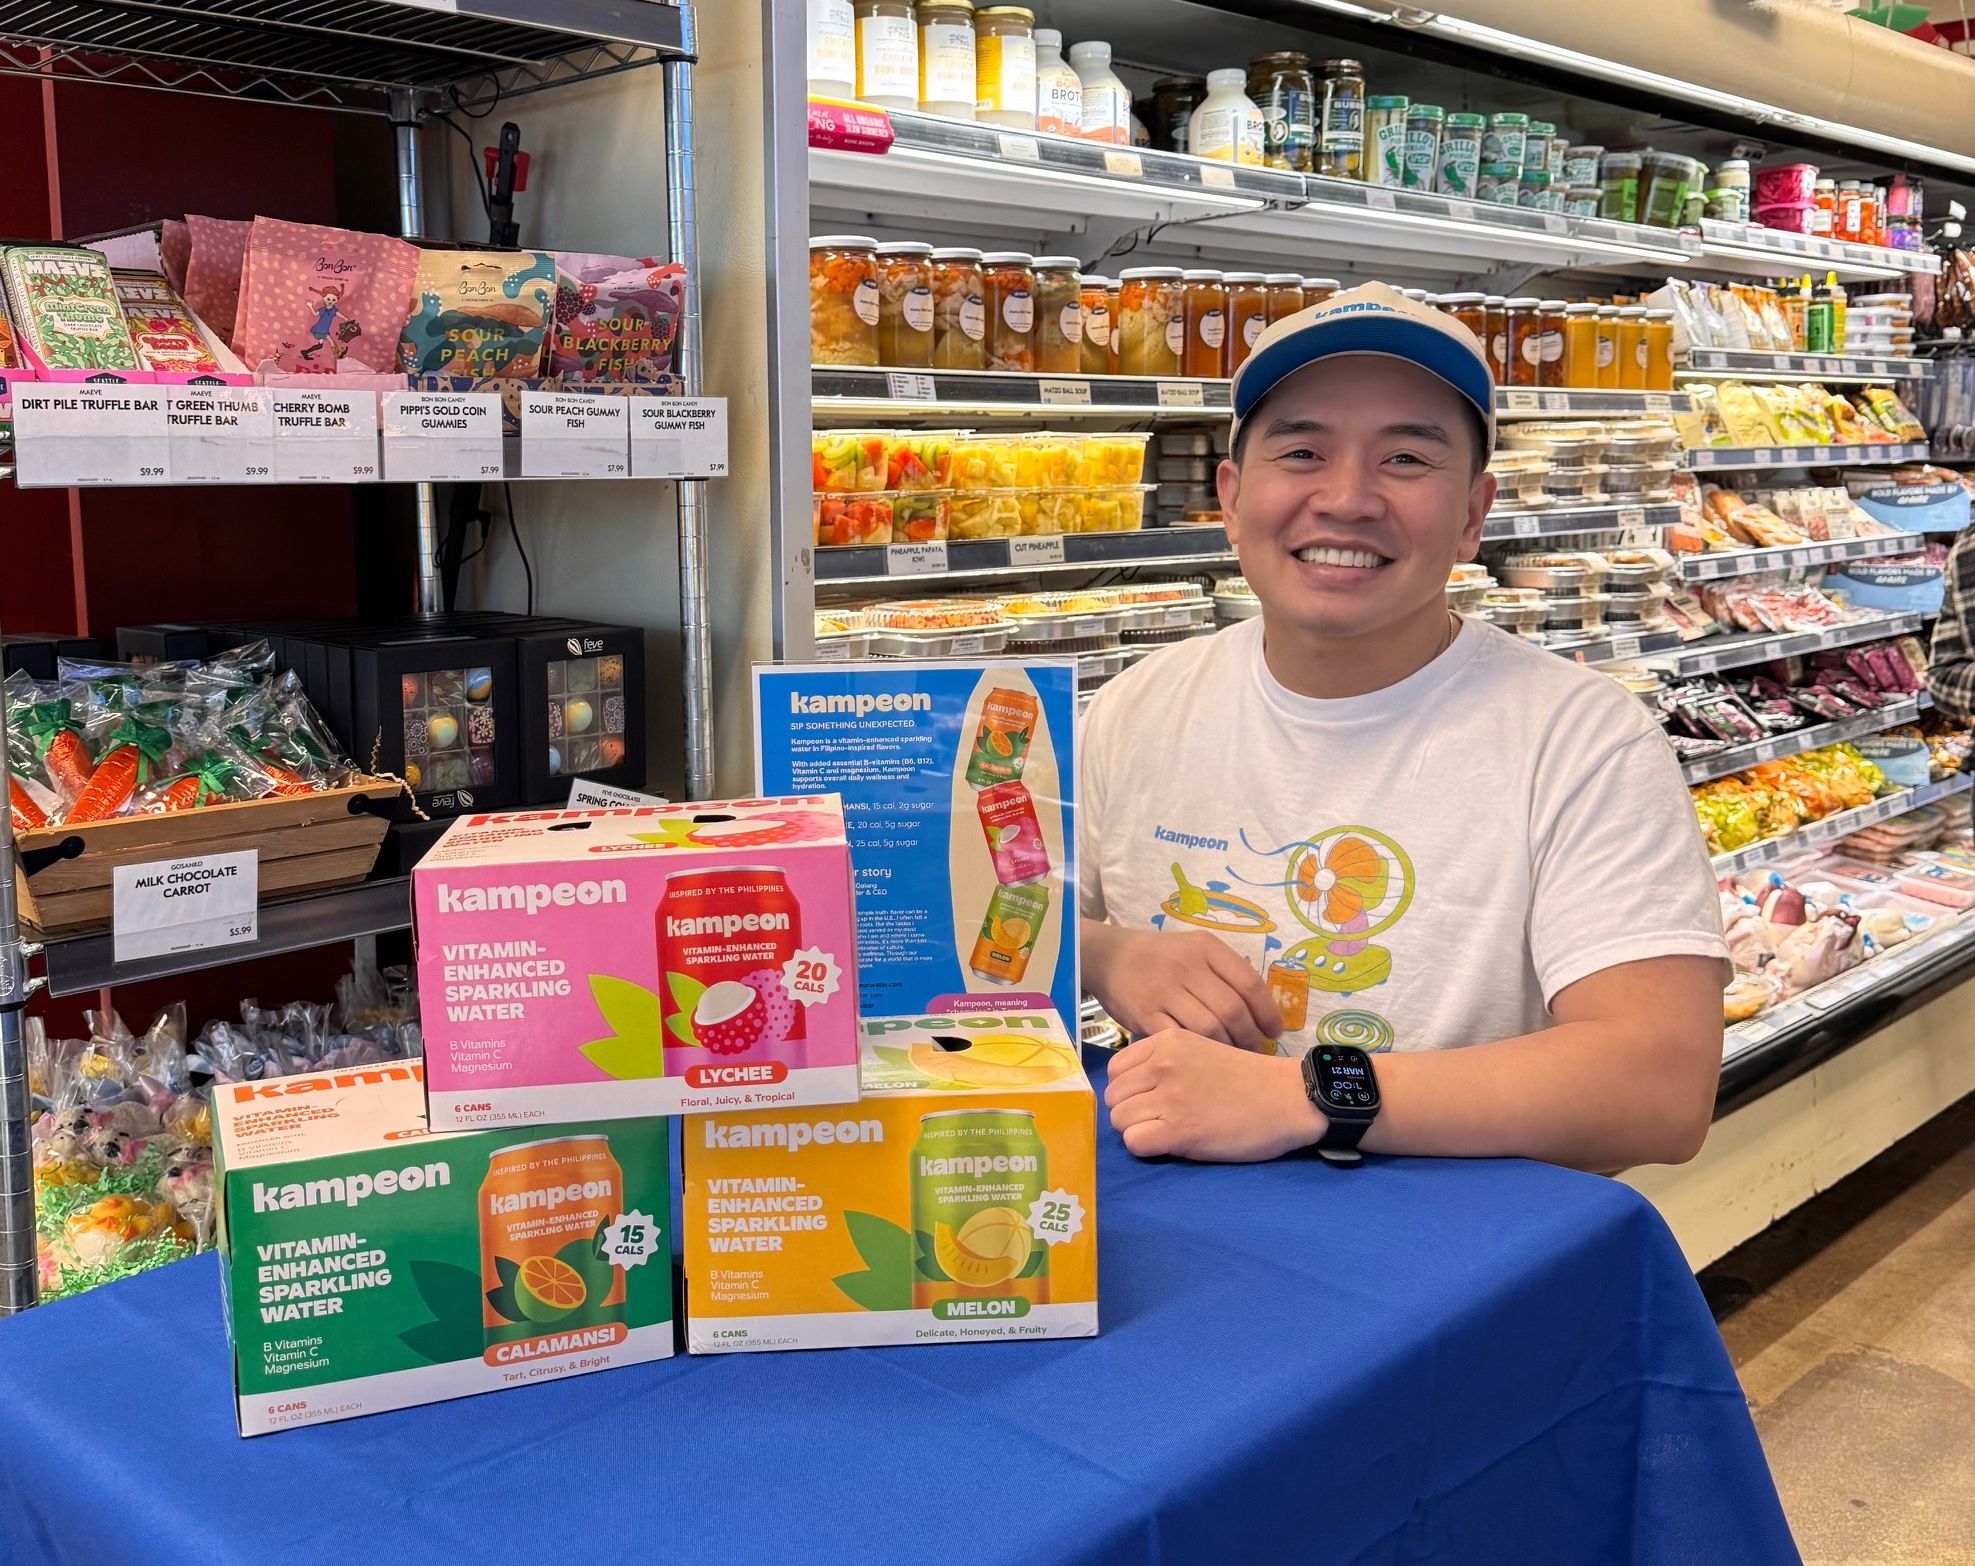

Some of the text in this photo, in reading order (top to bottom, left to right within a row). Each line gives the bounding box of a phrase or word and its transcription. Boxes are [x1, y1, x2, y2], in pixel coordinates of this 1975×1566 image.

[599, 318, 644, 332] SOUR
[449, 327, 505, 343] SOUR
[563, 336, 672, 351] BLACKBERRY
[441, 348, 509, 362] PEACH
[22, 399, 158, 412] DIRT PILE TRUFFLE BAR
[176, 400, 214, 412] GREEN
[217, 402, 259, 412] THUMB
[274, 402, 350, 414] CHERRY BOMB
[400, 404, 487, 416] PIPPI'S GOLD COIN
[530, 404, 620, 418] SOUR PEACH GUMMY
[216, 414, 238, 426] BAR
[642, 408, 716, 419] SOUR BLACKBERRY
[278, 416, 346, 428] TRUFFLE BAR
[422, 418, 468, 430] GUMMIES
[567, 418, 585, 429] FISH
[654, 420, 705, 431] GUMMY FISH
[140, 467, 164, 476] $9.99
[246, 466, 268, 476] $9.99
[353, 466, 374, 475] $9.99
[481, 466, 500, 474] $7.99
[608, 464, 624, 473] $7.99
[710, 463, 725, 472] $7.99
[1014, 542, 1059, 552] CUT PINEAPPLE
[791, 692, 932, 717] kampeon
[806, 722, 856, 730] SOMETHING
[860, 720, 916, 728] UNEXPECTED.
[576, 793, 607, 808] SPRING
[886, 821, 896, 830] 5g
[898, 822, 920, 830] sugar
[884, 840, 894, 848] 5g
[896, 840, 918, 848] sugar
[1154, 825, 1228, 852] kampeon
[171, 861, 203, 870] GOSANKO
[136, 866, 238, 888] MILK CHOCOLATE
[862, 868, 892, 878] story
[163, 883, 211, 898] CARROT
[438, 879, 626, 915] kampeon
[670, 884, 784, 899] INSPIRED BY THE PHILIPPINES
[998, 890, 1044, 912] kampeon
[230, 926, 252, 937] $5.99
[666, 913, 790, 938] kampeon
[442, 940, 546, 961] VITAMIN-
[682, 942, 777, 956] VITAMIN-ENHANCED
[686, 952, 775, 966] SPARKLING WATER
[444, 960, 566, 982] ENHANCED
[796, 960, 828, 982] 20
[446, 980, 572, 1002] SPARKLING
[794, 981, 825, 994] CALS
[954, 1000, 1028, 1008] Kampeon, meaning
[446, 1002, 525, 1022] WATER
[450, 1038, 506, 1050] B Vitamins
[450, 1050, 502, 1062] Vitamin C
[452, 1060, 512, 1074] Magnesium
[1332, 1066, 1364, 1076] MAR 21
[700, 1066, 773, 1084] LYCHEE
[681, 1092, 796, 1108] Floral, Juicy, & Tropical
[455, 1103, 492, 1112] 6 CANS
[705, 1120, 884, 1152] kampeon
[920, 1155, 1038, 1178] kampeon
[253, 1162, 450, 1214] kampeon
[708, 1176, 805, 1194] VITAMIN-
[934, 1183, 1024, 1195] VITAMIN-ENHANCED
[490, 1180, 612, 1216] kampeon
[708, 1196, 824, 1214] ENHANCED
[938, 1192, 1022, 1204] SPARKLING WATER
[1042, 1201, 1071, 1222] 25
[509, 1220, 596, 1242] SPARKLING WATER
[708, 1214, 828, 1234] SPARKLING
[1039, 1221, 1069, 1233] CALS
[620, 1224, 645, 1244] 15
[257, 1232, 367, 1262] VITAMIN-
[614, 1245, 644, 1255] CALS
[708, 1236, 784, 1253] WATER
[258, 1250, 387, 1284] ENHANCED
[259, 1269, 392, 1304] SPARKLING
[260, 1297, 344, 1324] WATER
[948, 1300, 1016, 1316] MELON
[916, 1326, 1048, 1338] Delicate, Honeyed, & Fruity
[264, 1336, 323, 1352] B Vitamins
[496, 1327, 616, 1362] CALAMANSI
[264, 1347, 319, 1363] Vitamin C
[265, 1358, 330, 1376] Magnesium
[503, 1356, 610, 1382] Tart, Citrusy, & Bright
